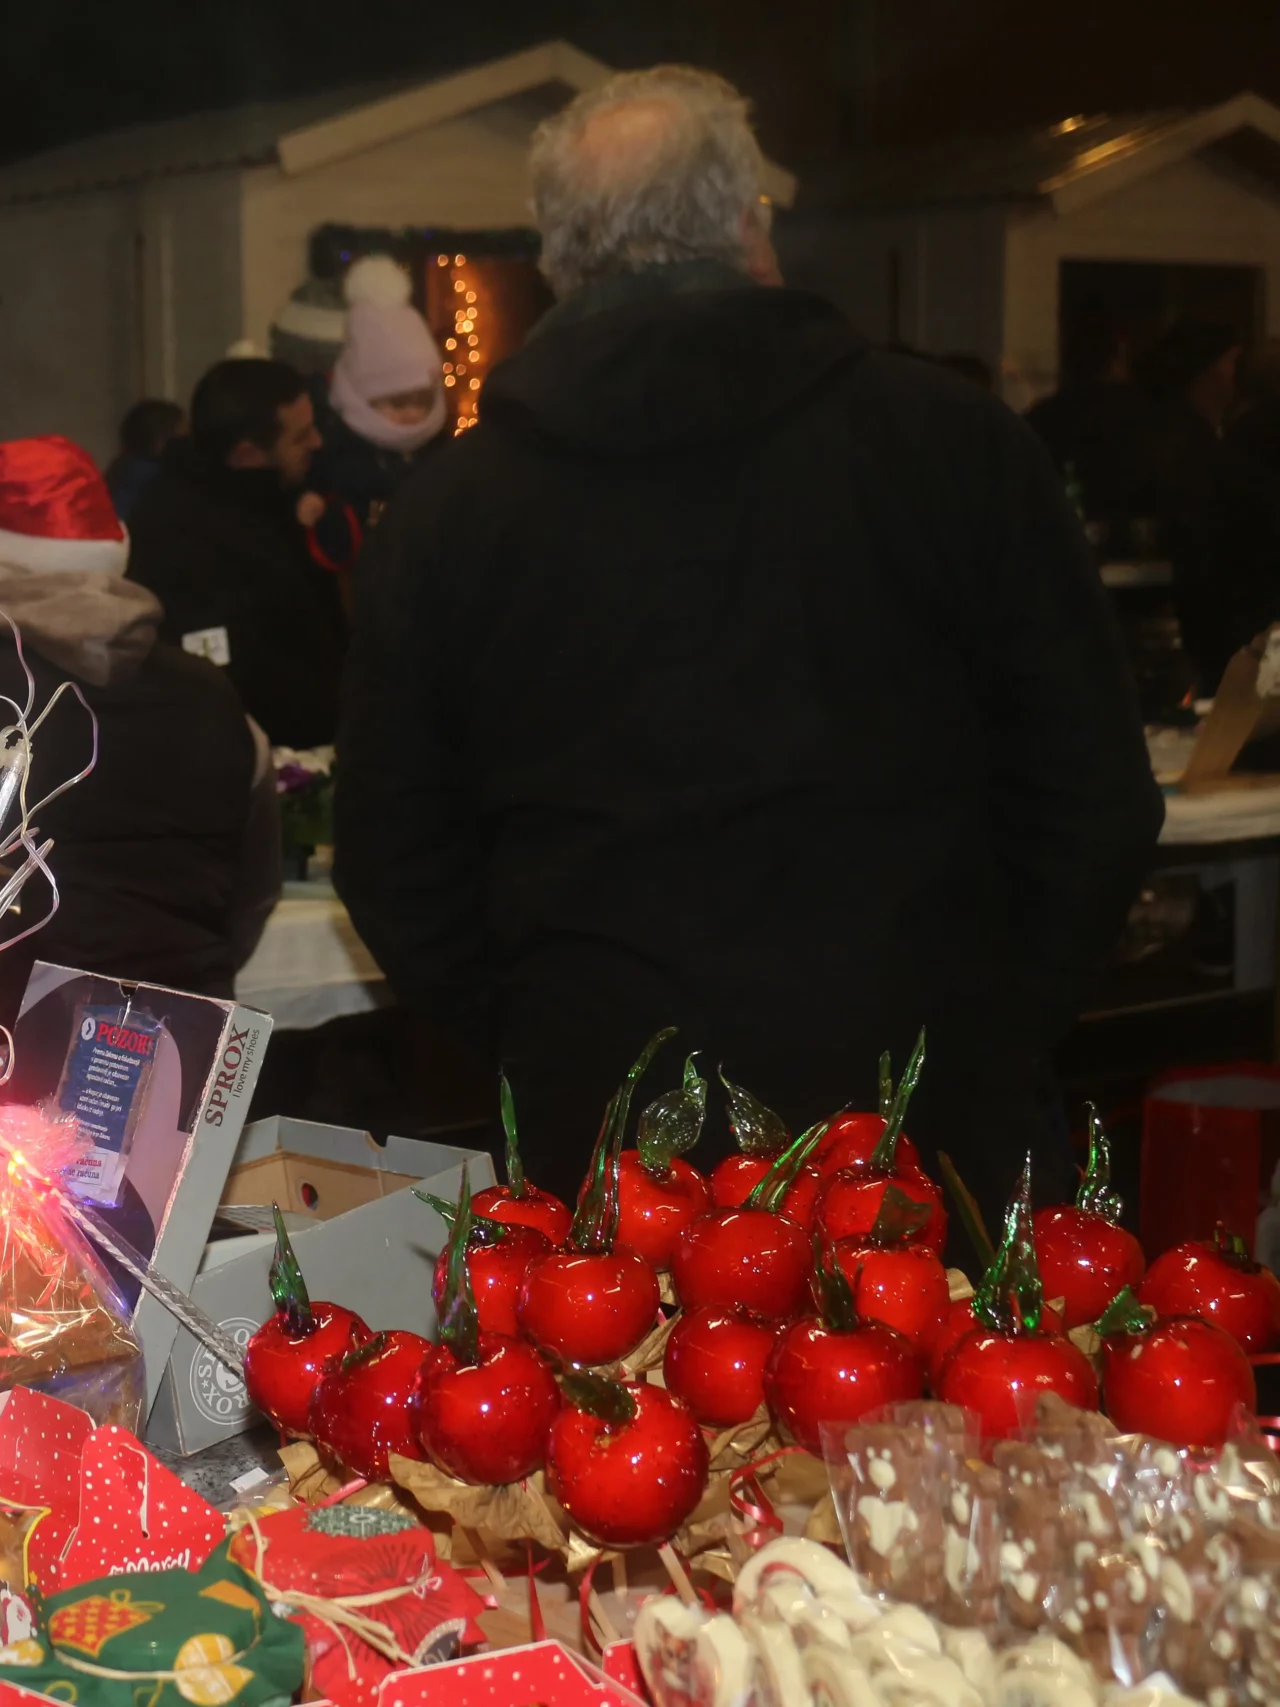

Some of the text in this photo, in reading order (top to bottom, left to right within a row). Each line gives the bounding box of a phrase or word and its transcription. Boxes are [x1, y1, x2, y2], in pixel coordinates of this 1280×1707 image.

[246, 1029, 260, 1056] shoes
[204, 1023, 250, 1128] SPROX
[242, 1057, 253, 1073] my
[236, 1073, 247, 1095] love
